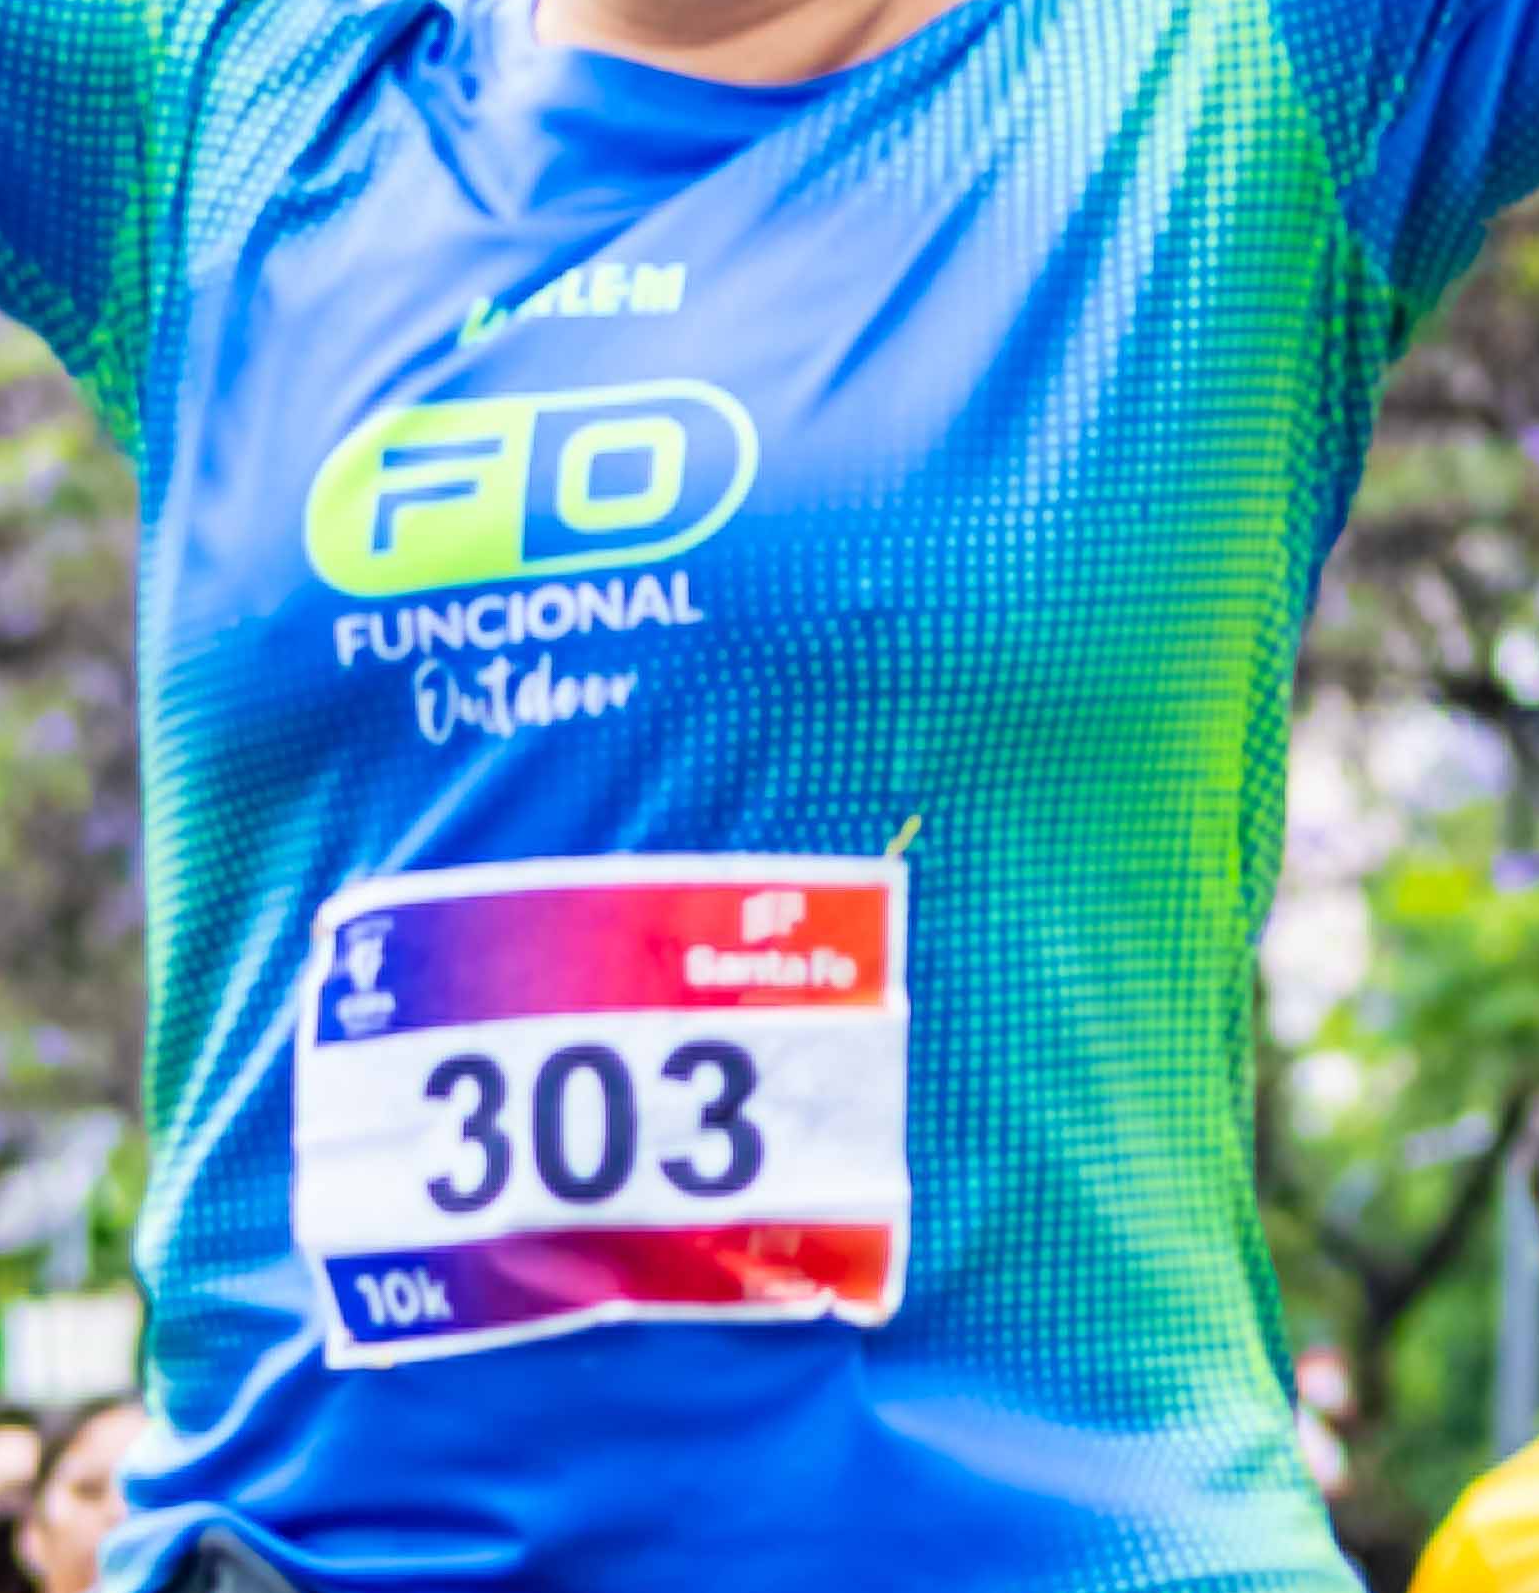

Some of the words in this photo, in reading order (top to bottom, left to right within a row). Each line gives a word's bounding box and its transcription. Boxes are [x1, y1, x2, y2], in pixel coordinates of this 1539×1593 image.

[333, 570, 704, 667] FUNCIONAL
[424, 1040, 763, 1212] 303
[356, 1269, 452, 1325] 10k
